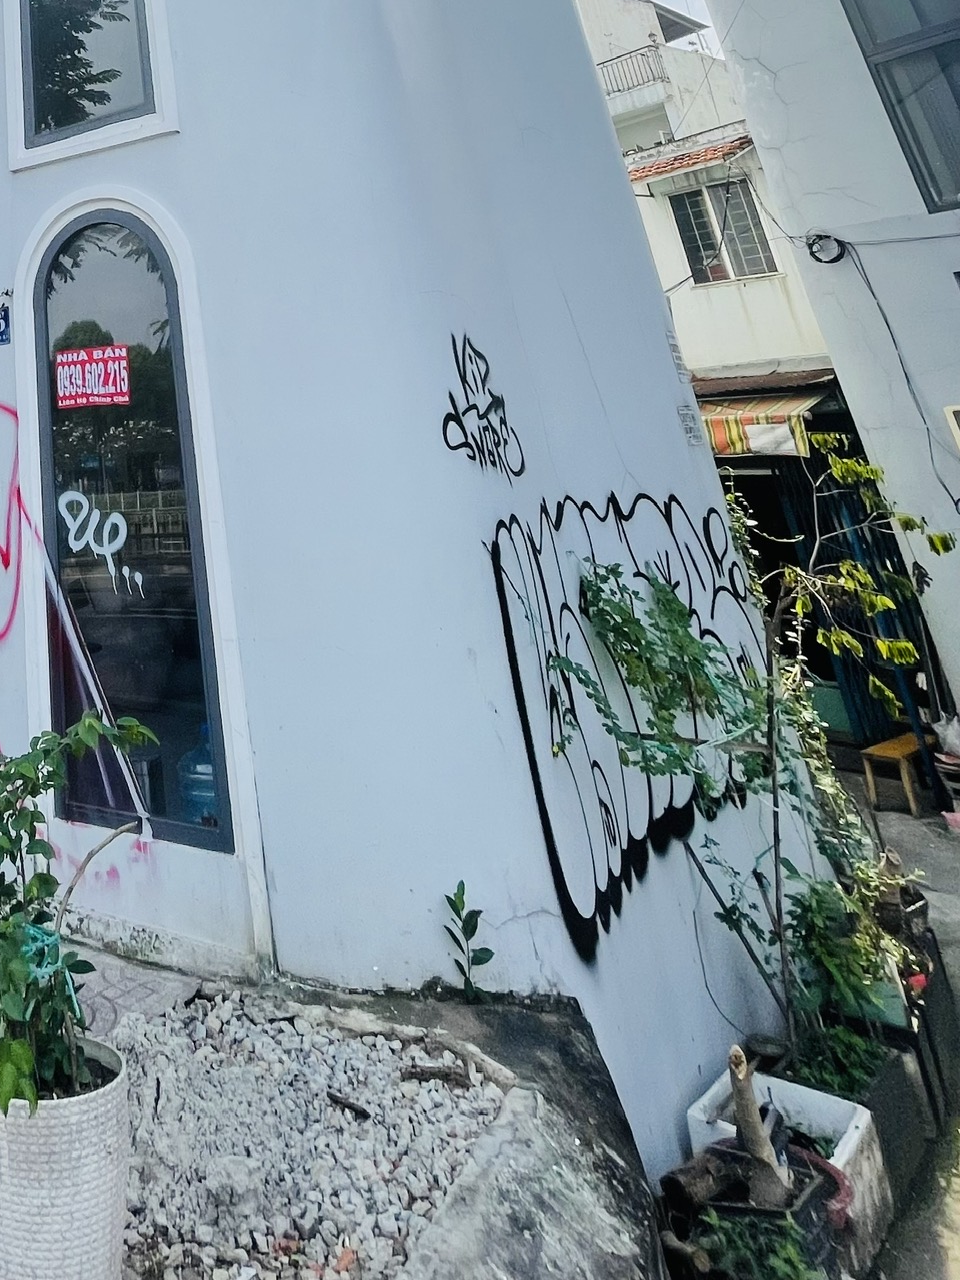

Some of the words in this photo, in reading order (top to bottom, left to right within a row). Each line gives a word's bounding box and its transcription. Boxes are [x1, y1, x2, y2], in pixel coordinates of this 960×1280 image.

[57, 349, 88, 362] NHÀ
[93, 347, 126, 359] BÁN
[57, 360, 128, 397] 0939.602.215
